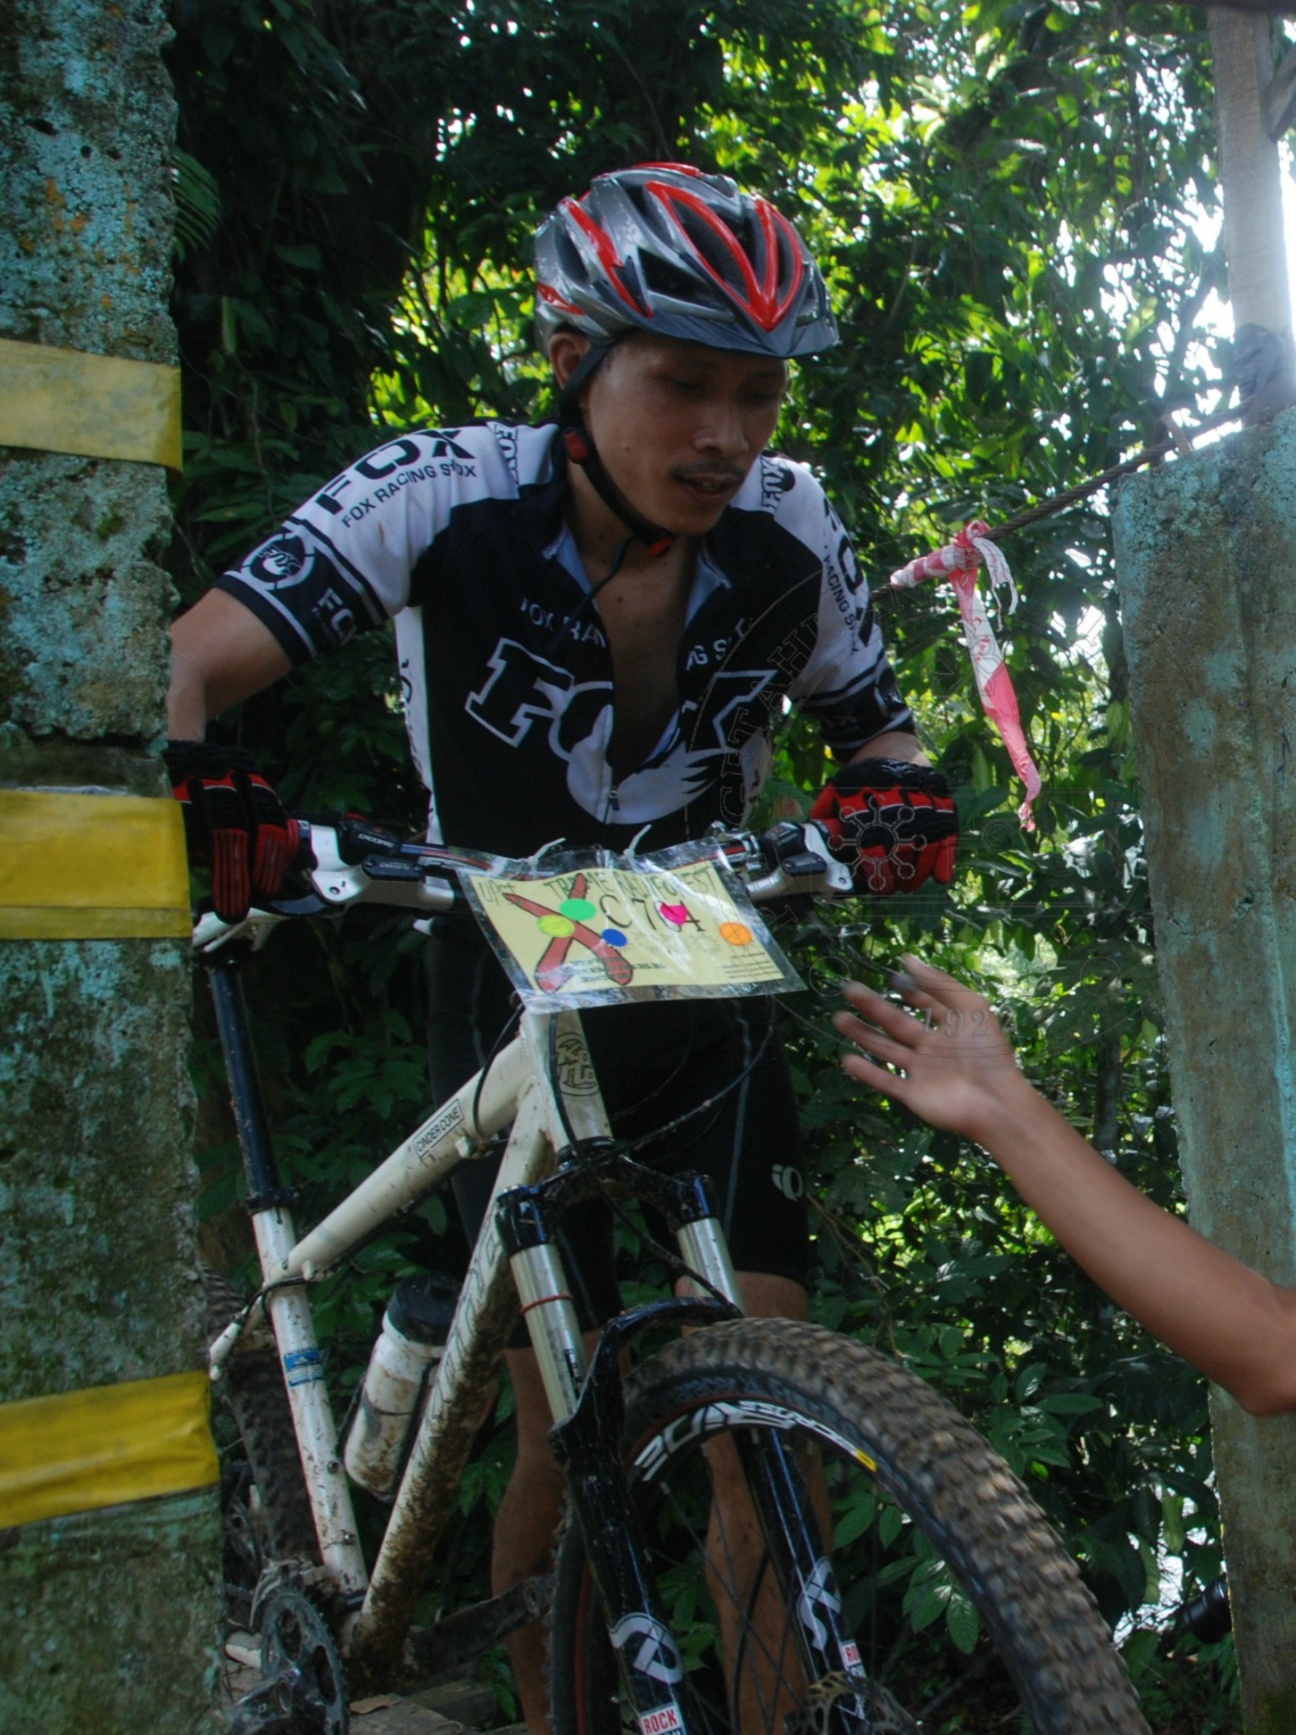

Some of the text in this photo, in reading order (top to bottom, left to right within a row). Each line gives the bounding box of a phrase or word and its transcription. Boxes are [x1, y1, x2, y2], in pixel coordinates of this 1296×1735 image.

[315, 430, 475, 515] FOX
[342, 497, 377, 527] FOX
[377, 464, 437, 502] RACING
[415, 1106, 463, 1154] CINDER CONE
[642, 1708, 679, 1733] ROCK
